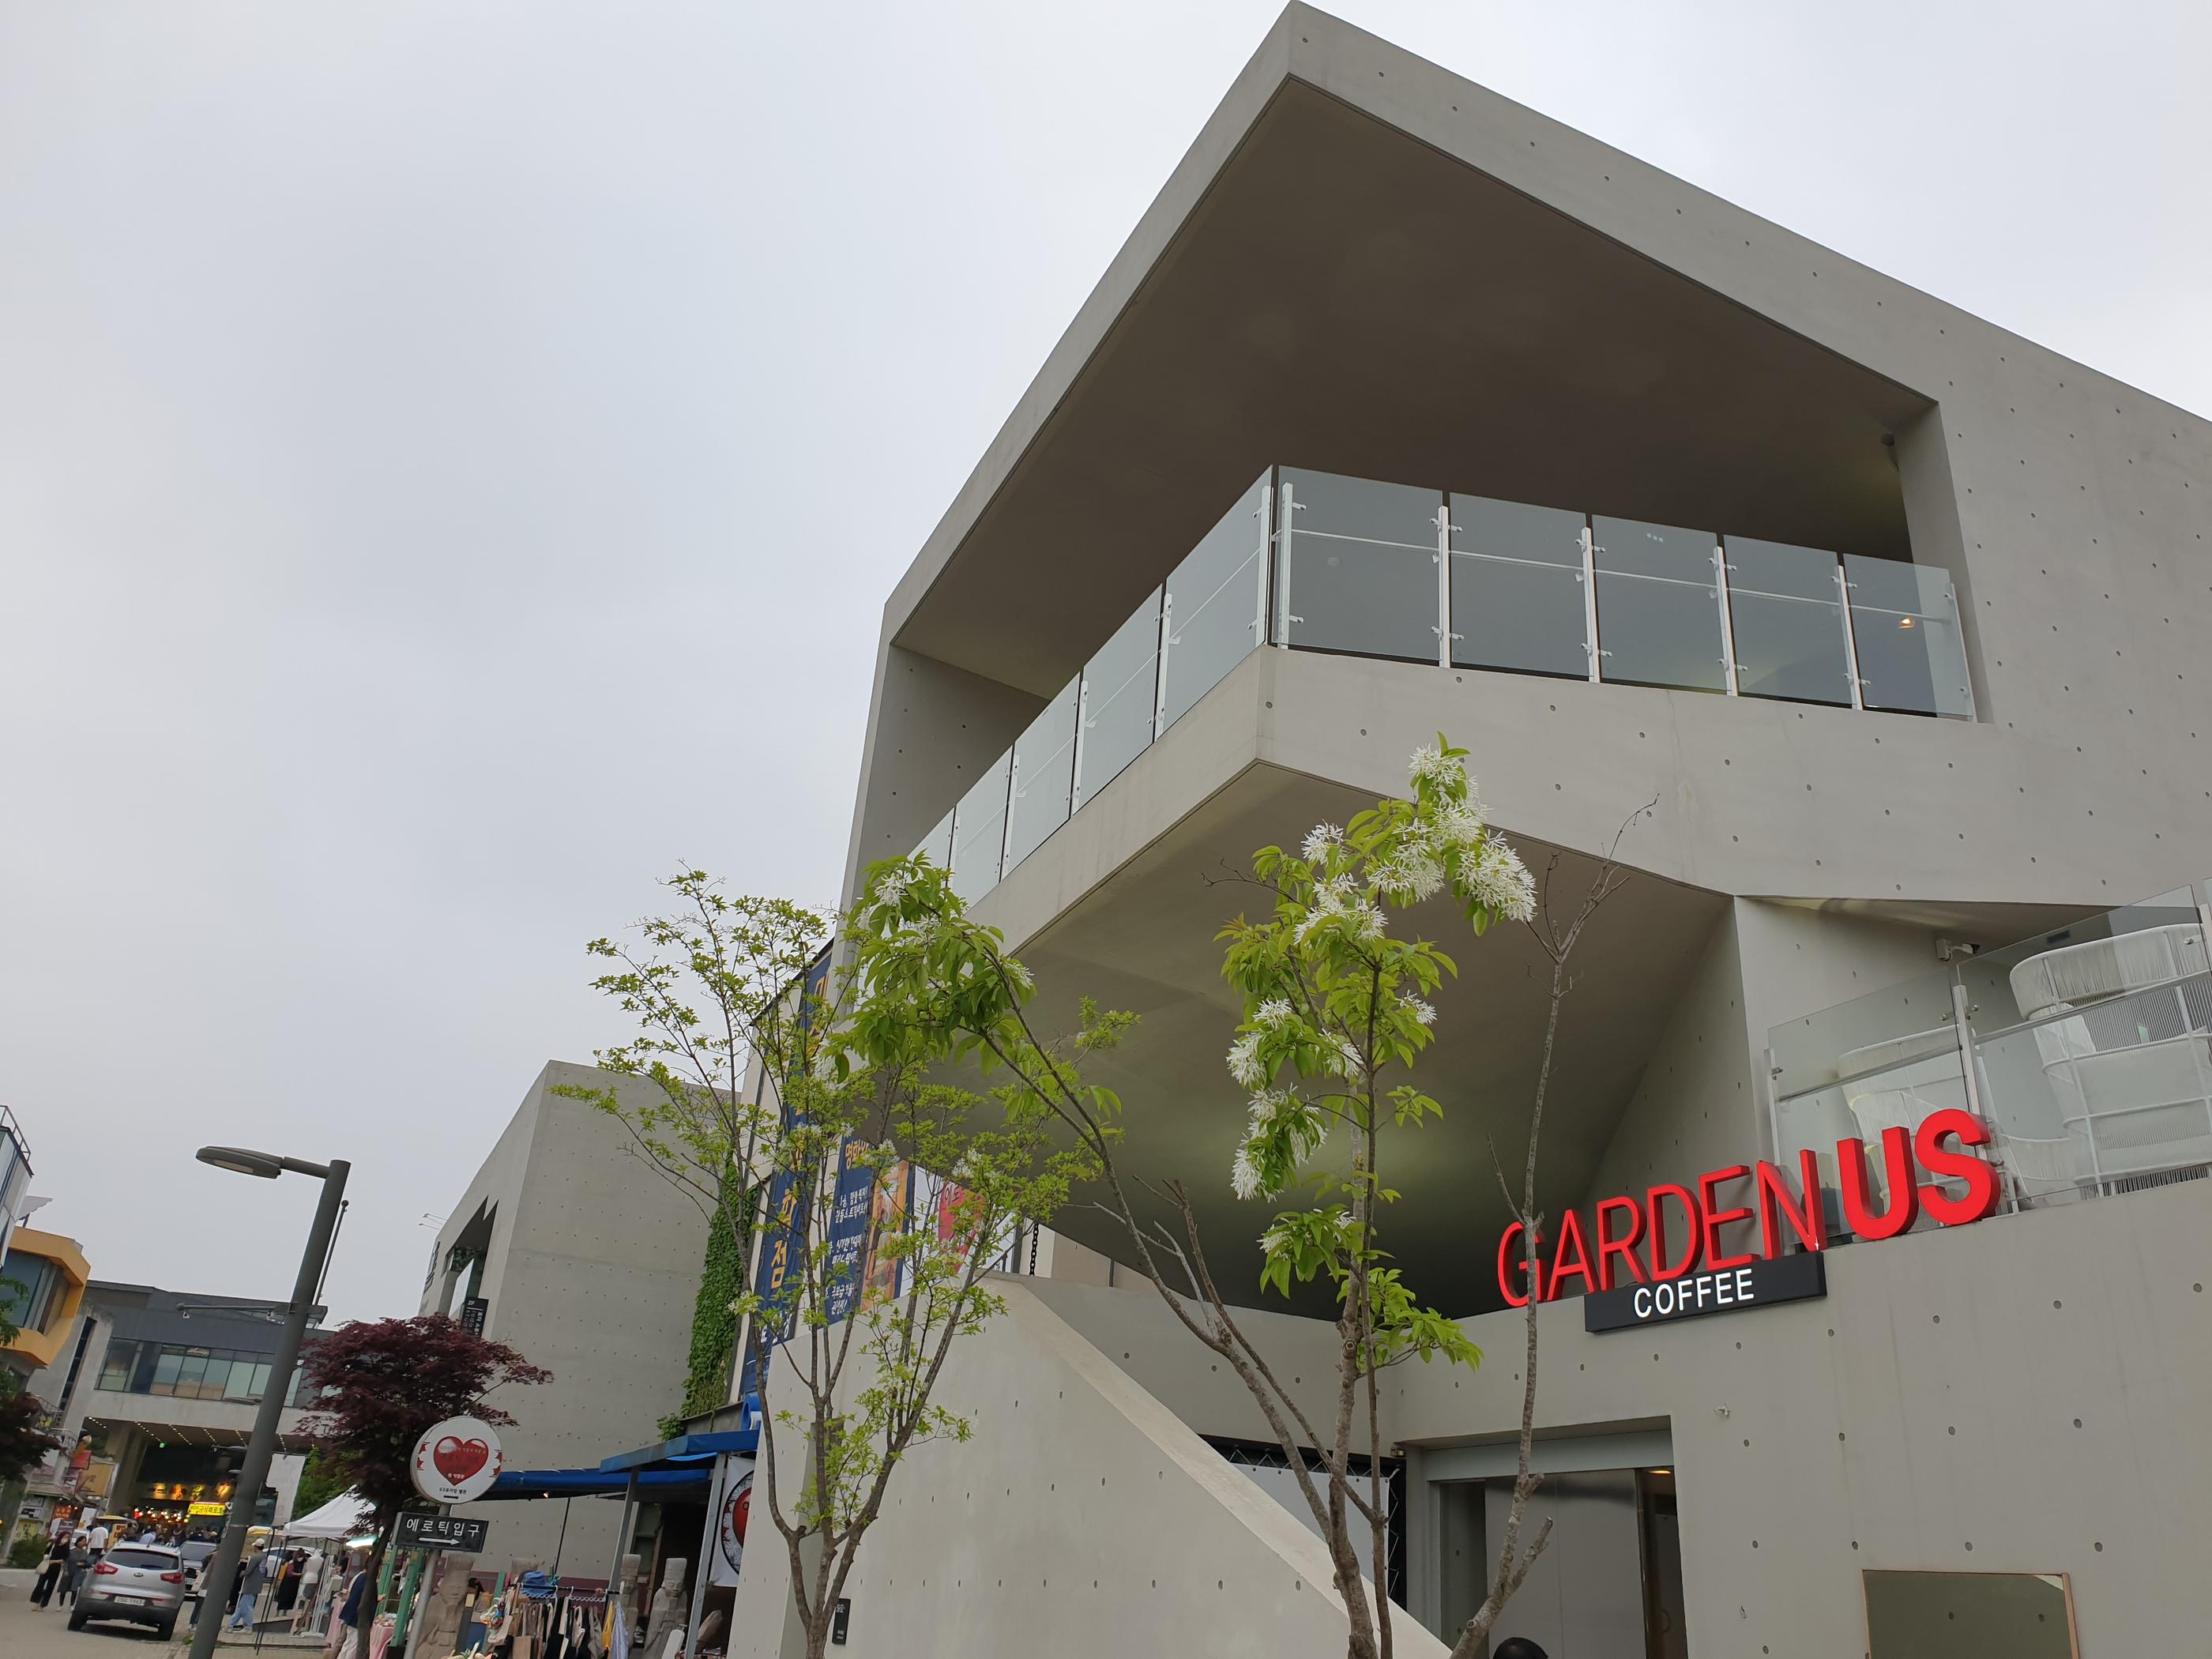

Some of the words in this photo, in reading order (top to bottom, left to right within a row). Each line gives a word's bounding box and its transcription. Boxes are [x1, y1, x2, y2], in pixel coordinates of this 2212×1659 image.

[1497, 1149, 1827, 1308] GARDEN
[1837, 1108, 2001, 1240] US
[1634, 1269, 1755, 1319] COFFEE
[406, 1518, 480, 1538] 에로틱입구
